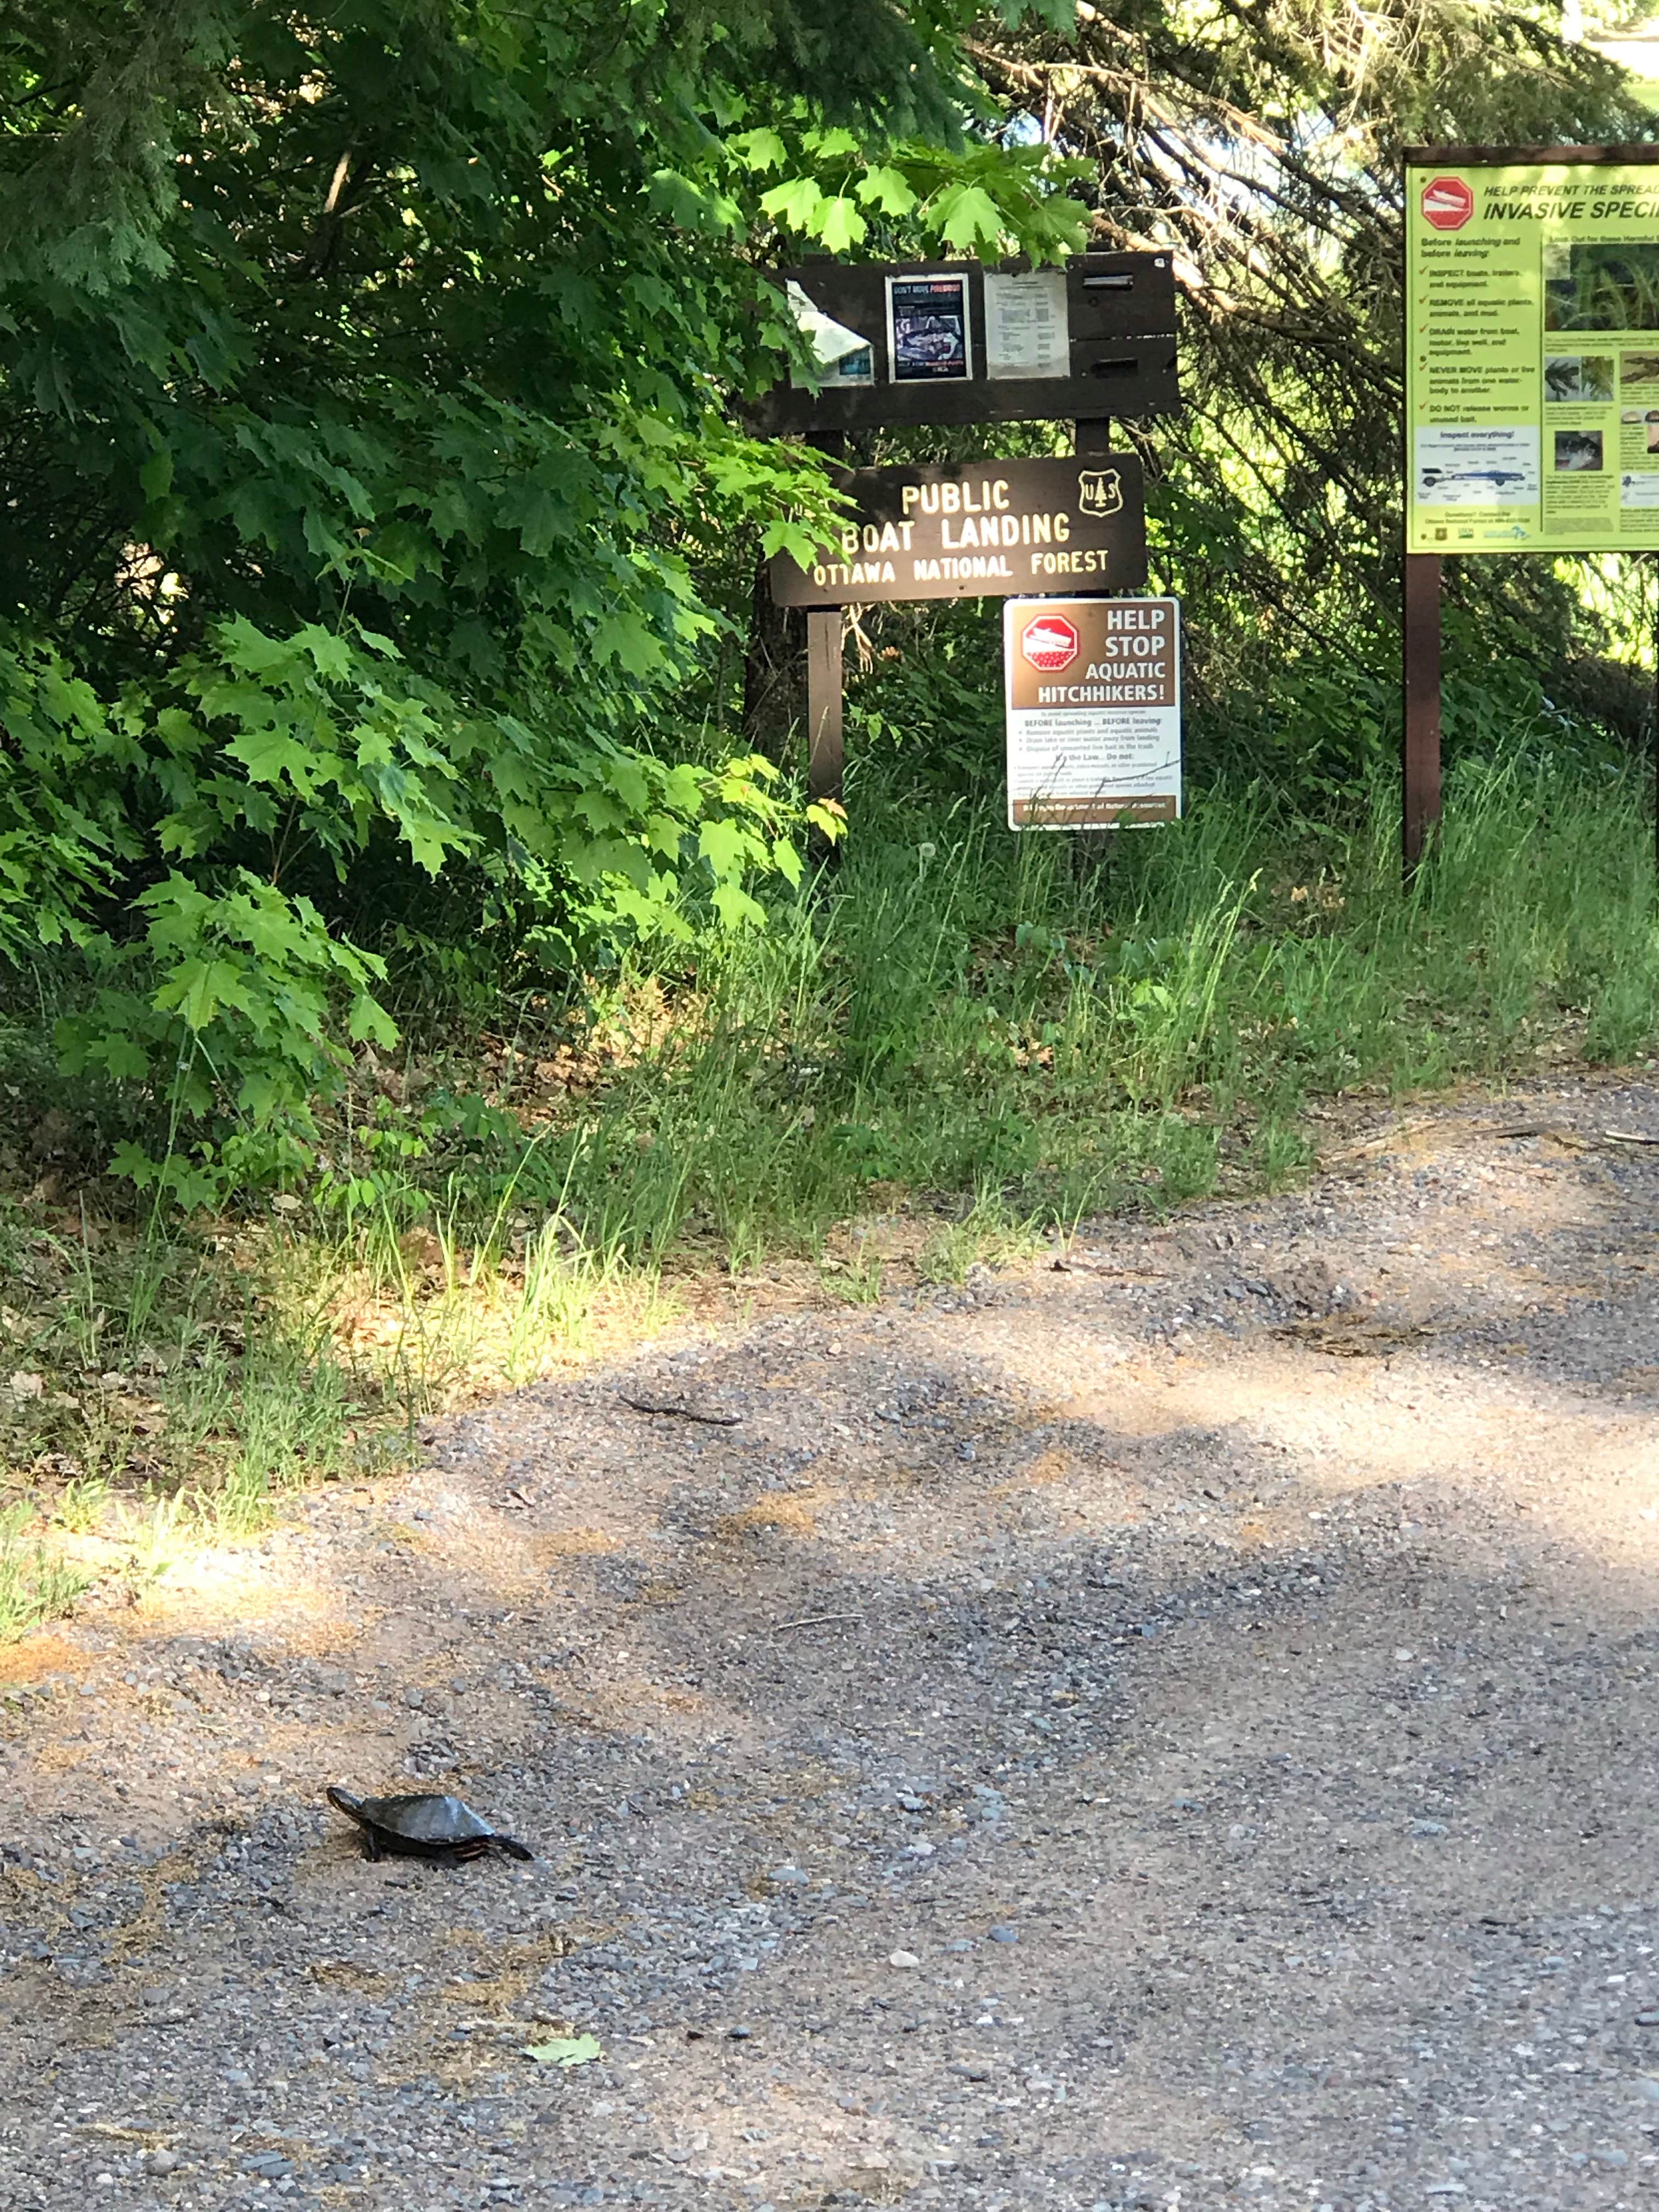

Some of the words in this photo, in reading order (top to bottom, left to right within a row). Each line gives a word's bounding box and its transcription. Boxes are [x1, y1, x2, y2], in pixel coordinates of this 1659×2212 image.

[1484, 186, 1519, 196] HELP
[1520, 185, 1579, 196] PREVENT
[1583, 184, 1608, 195] THE
[1483, 201, 1586, 220] INVASIVE
[1590, 201, 1659, 219] SPECI
[1455, 238, 1502, 247] launching
[1421, 249, 1451, 257] before
[1440, 431, 1469, 439] Inspect
[902, 479, 1009, 515] PUBLIC
[842, 521, 915, 554] BOAT
[941, 513, 1070, 549] LANDING
[814, 561, 896, 586] OTTAWA
[913, 555, 1013, 580] NATIONAL
[1031, 550, 1109, 575] FOREST
[1107, 610, 1165, 630] HELP
[1105, 636, 1165, 657] STOP
[1085, 662, 1166, 682] AQUATIC
[1038, 685, 1164, 703] HITCHHIKERS!
[1055, 719, 1092, 727] launching
